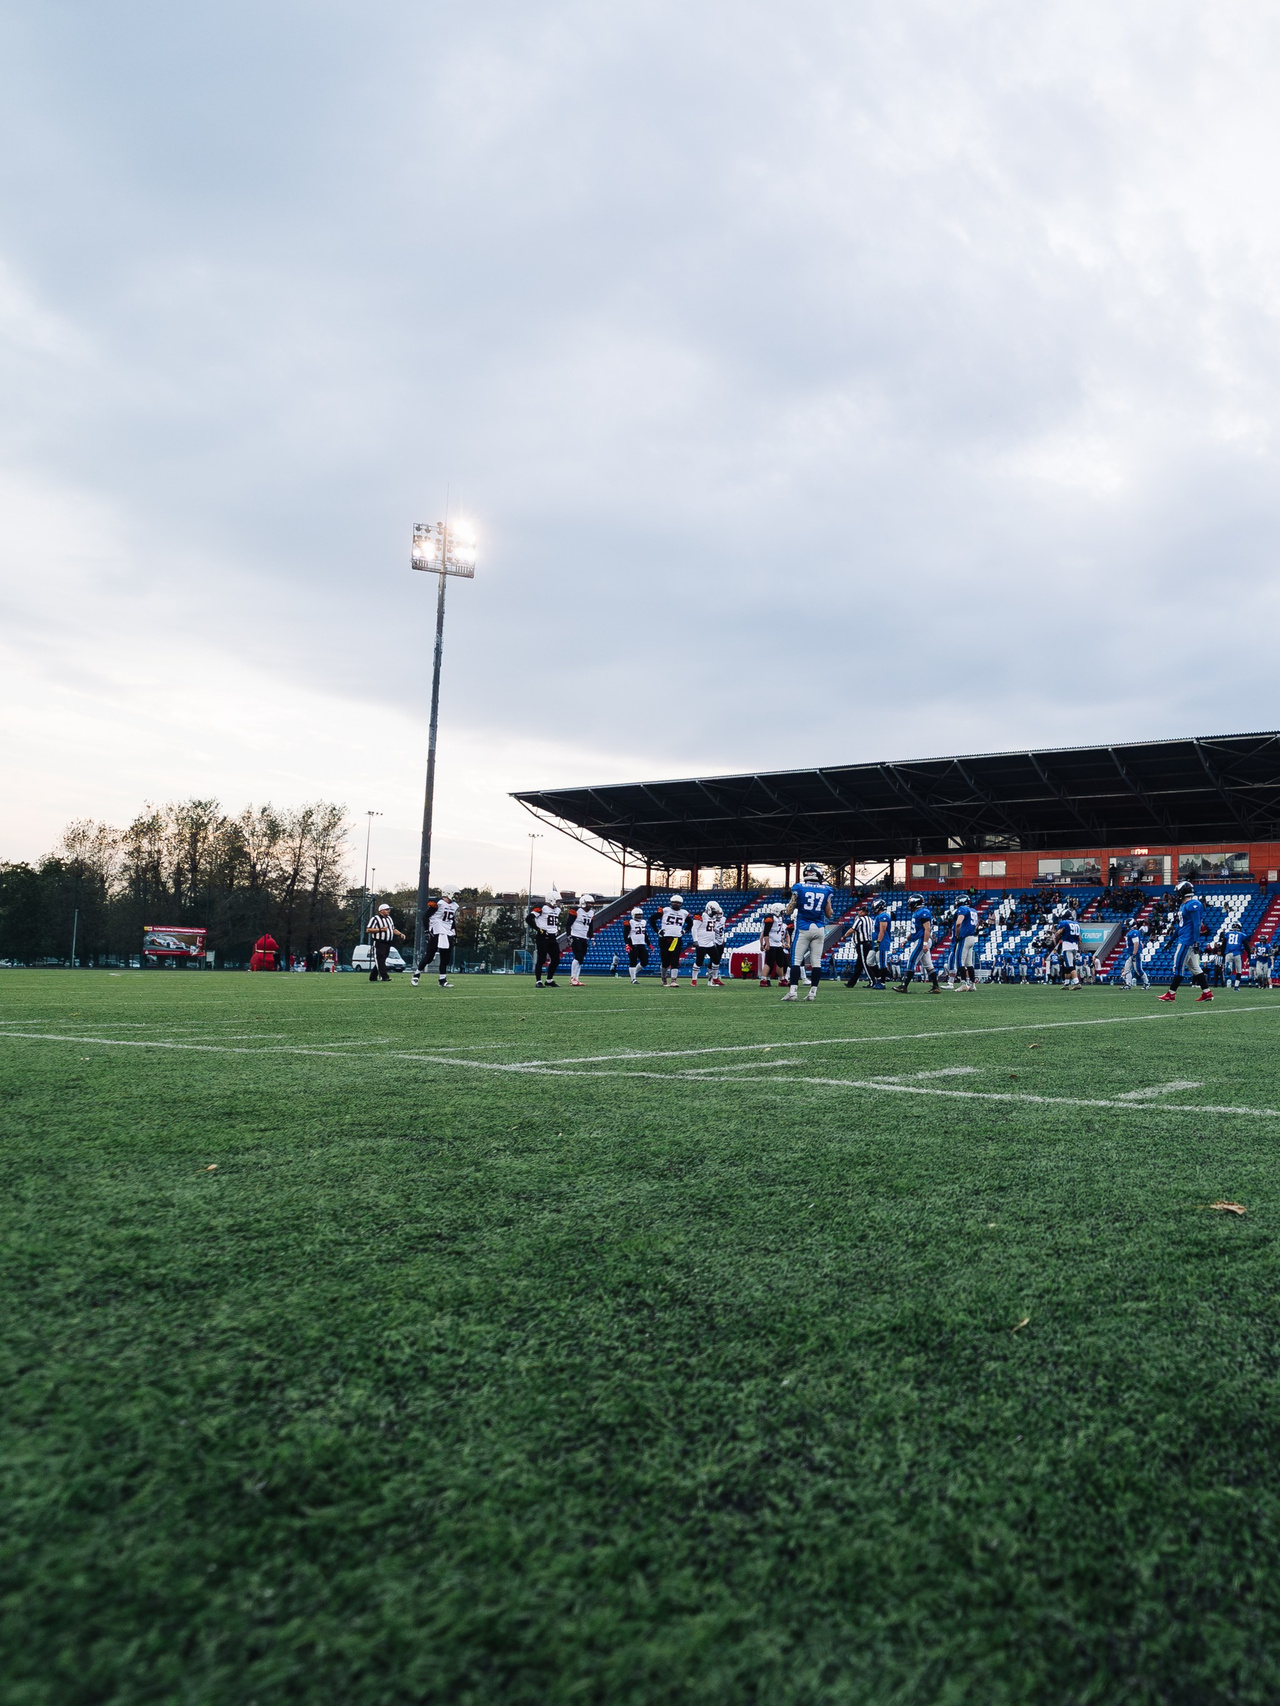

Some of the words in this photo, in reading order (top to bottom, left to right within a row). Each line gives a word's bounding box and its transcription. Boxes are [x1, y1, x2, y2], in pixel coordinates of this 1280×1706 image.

[803, 891, 825, 912] 37
[1069, 923, 1081, 935] 90
[1228, 933, 1239, 945] 81
